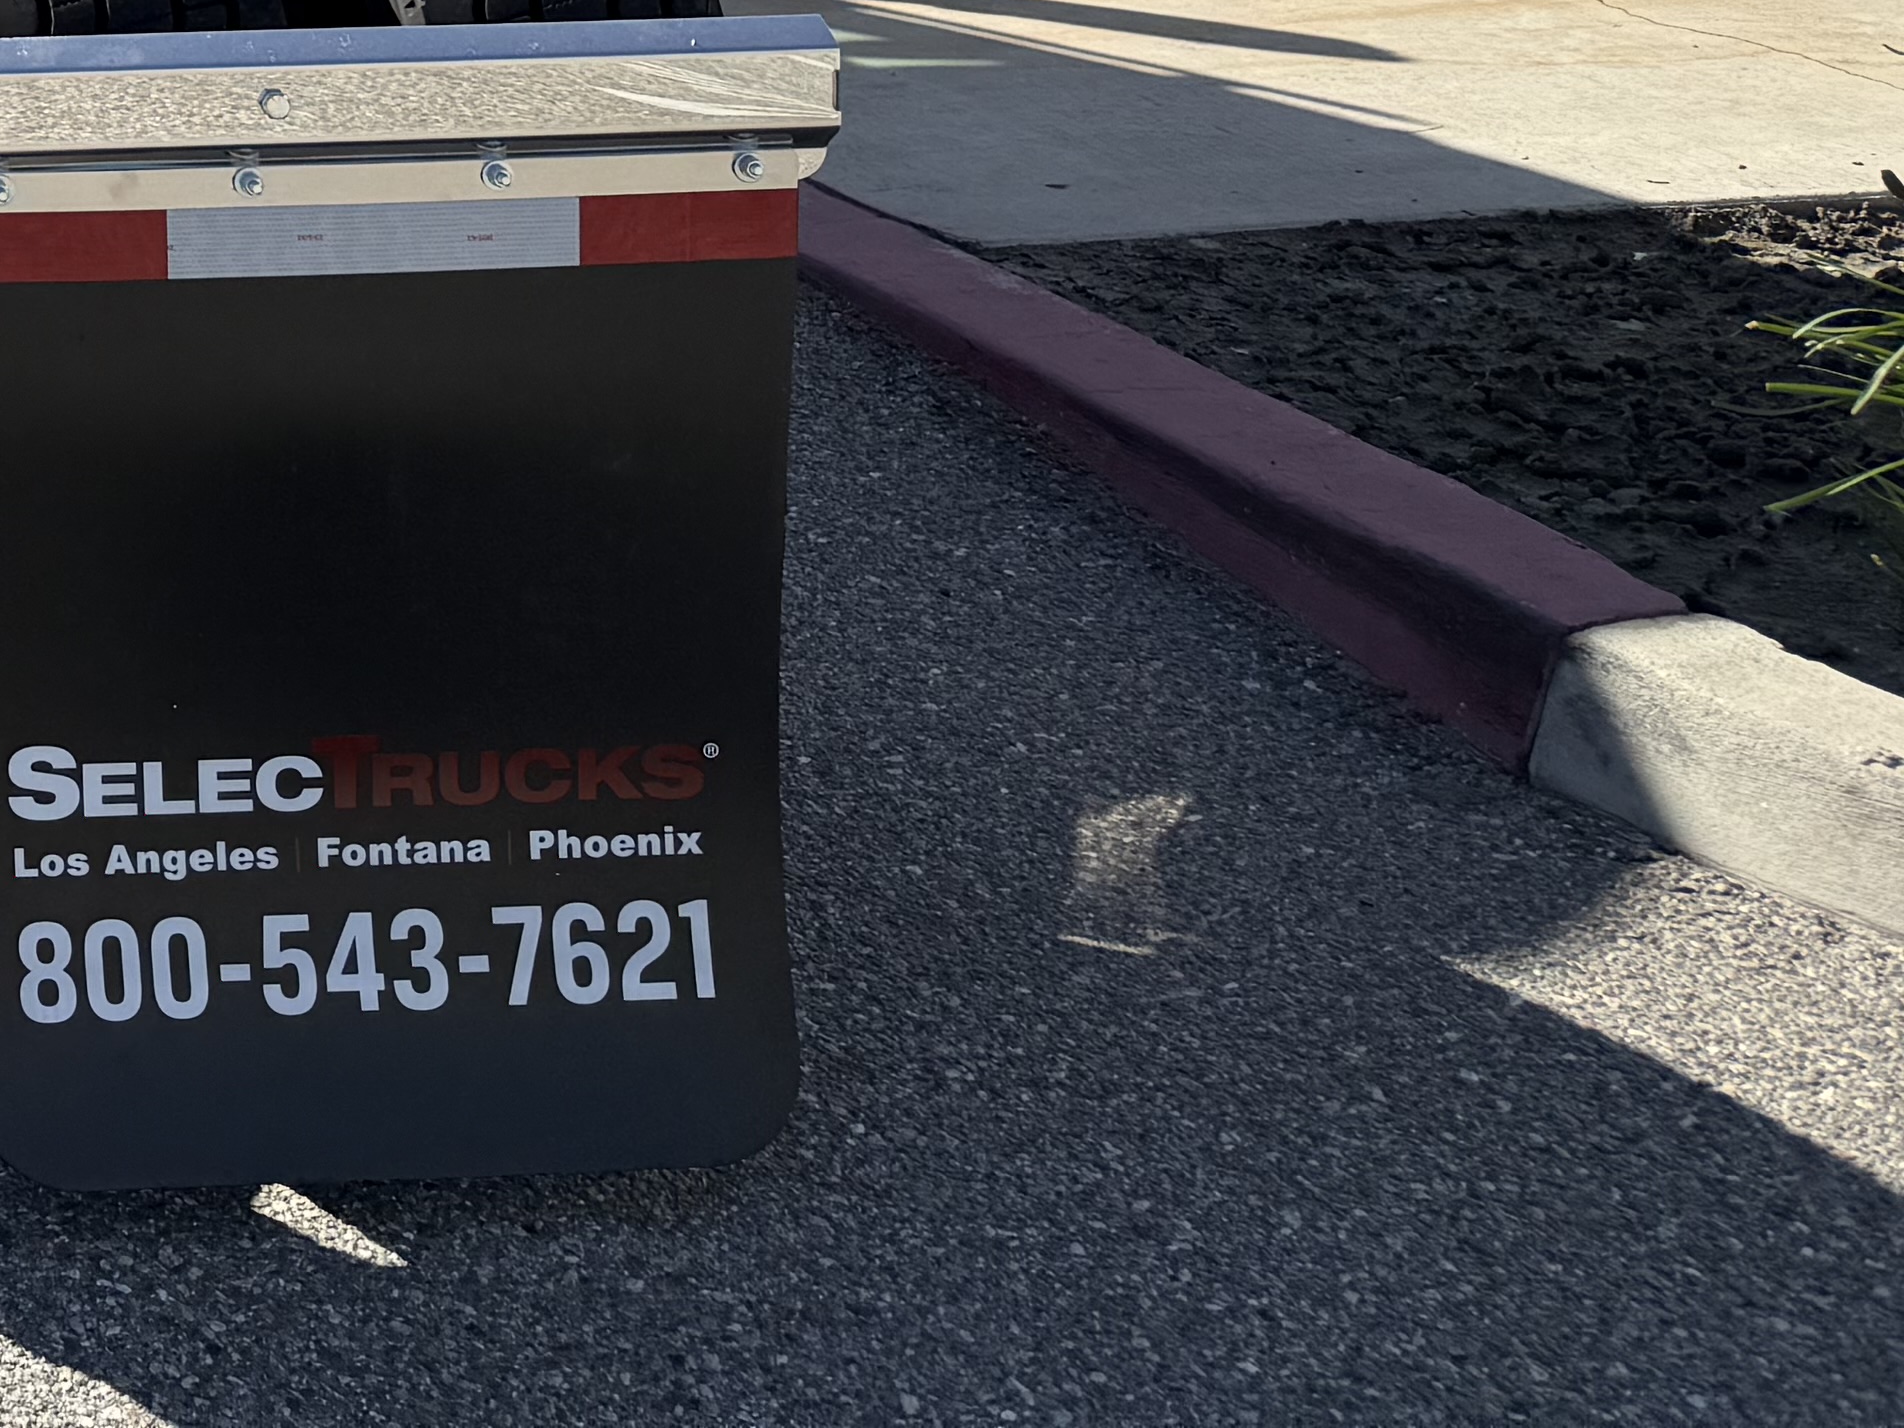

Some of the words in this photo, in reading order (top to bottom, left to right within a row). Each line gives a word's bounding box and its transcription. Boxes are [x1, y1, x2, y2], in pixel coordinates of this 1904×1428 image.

[13, 847, 90, 878] Los
[104, 840, 279, 881] Angeles
[317, 835, 491, 868] Fontana
[529, 825, 704, 860] Phoenix
[18, 899, 717, 1024] 800-543-7621
